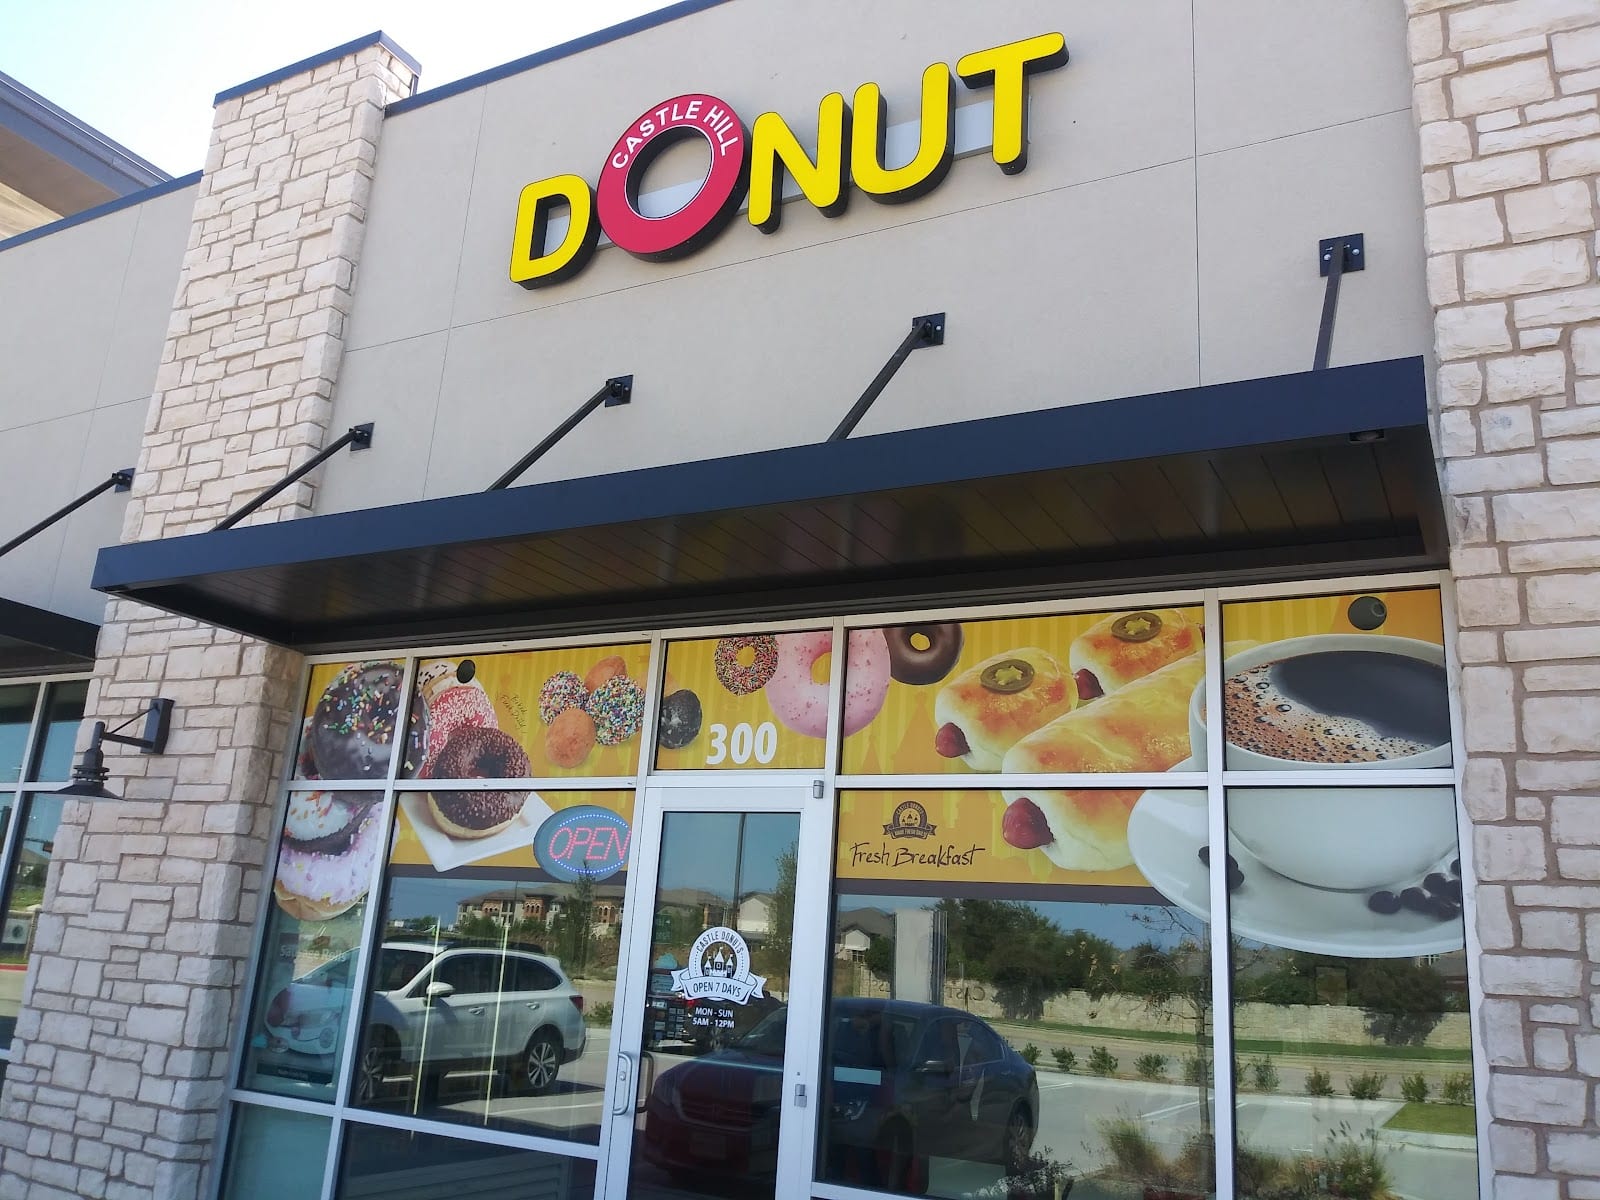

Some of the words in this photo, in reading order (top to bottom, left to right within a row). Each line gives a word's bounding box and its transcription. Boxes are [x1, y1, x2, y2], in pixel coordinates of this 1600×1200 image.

[612, 100, 703, 169] CASTLE
[703, 105, 739, 157] HILL
[510, 31, 1067, 285] DONUT
[706, 721, 778, 765] 300
[548, 826, 632, 860] OPEN
[850, 842, 890, 867] Fresh
[892, 844, 986, 868] Breakfast
[280, 945, 320, 959] Sauage
[696, 930, 720, 953] CASTLE
[721, 931, 744, 954] DONUTS
[693, 981, 714, 993] OPEN
[715, 982, 721, 992] 7
[721, 982, 742, 998] DAYS
[692, 1017, 709, 1027] 5AM
[715, 1019, 735, 1029] 12PM
[695, 1007, 713, 1017] MON
[719, 1009, 734, 1018] SUN
